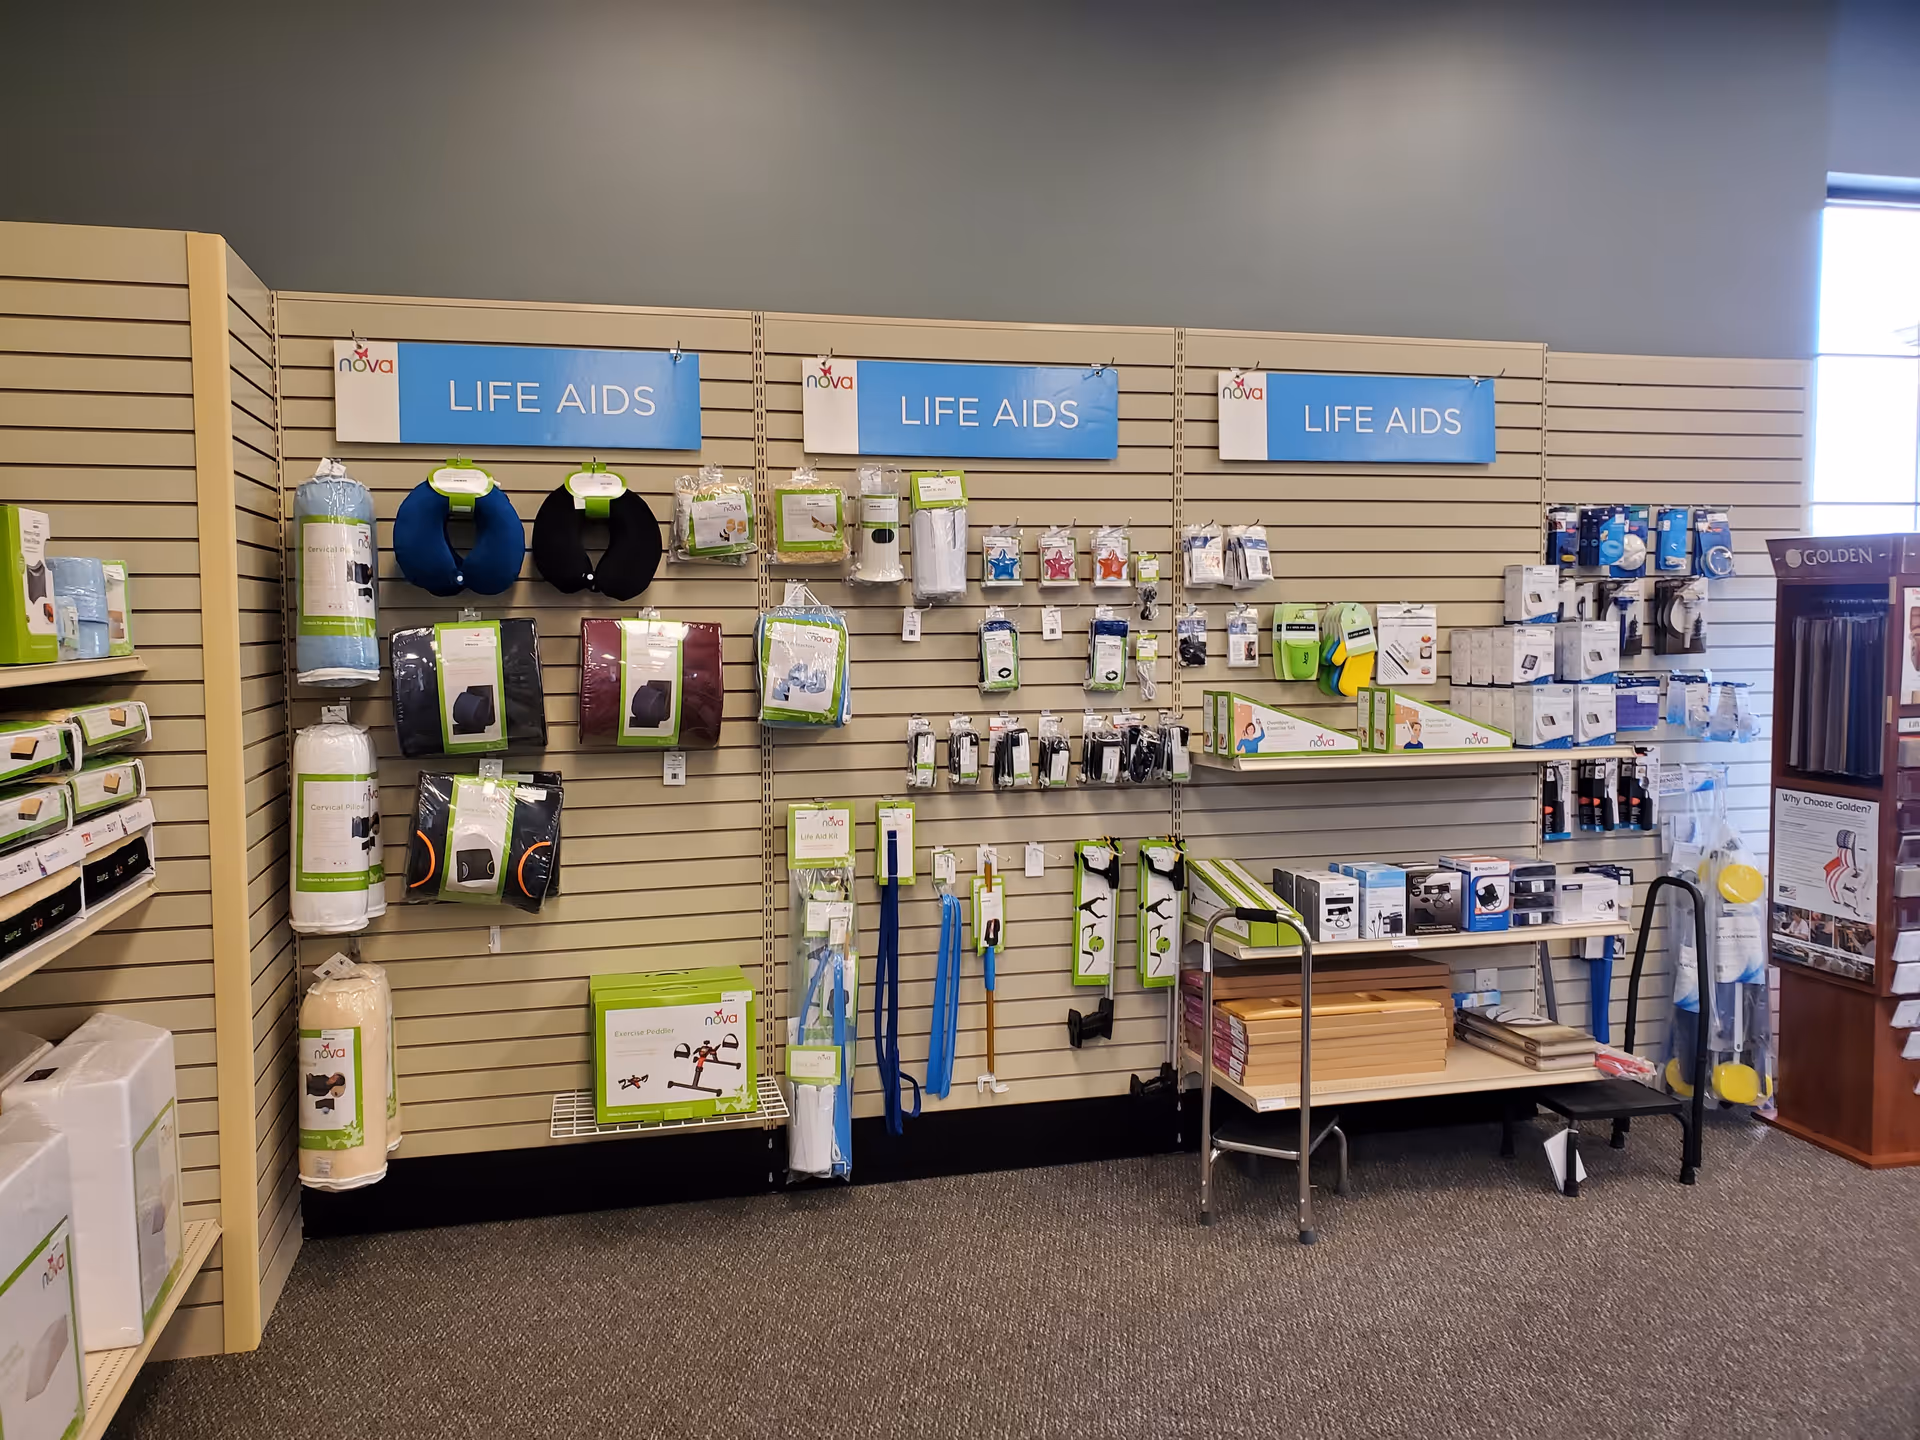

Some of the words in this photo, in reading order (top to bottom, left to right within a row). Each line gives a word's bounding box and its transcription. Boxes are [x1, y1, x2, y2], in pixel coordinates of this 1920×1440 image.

[339, 355, 394, 374] nova
[805, 372, 854, 391] nova
[449, 379, 541, 413] LIFE
[556, 383, 657, 416] AIDS
[1221, 384, 1263, 402] nova
[900, 395, 980, 428] LIFE
[991, 398, 1080, 430] AIDS
[1304, 405, 1373, 433] LIFE
[1385, 407, 1462, 436] AIDS
[307, 545, 338, 554] Cervical
[1803, 546, 1873, 566] GOLDEN
[810, 635, 833, 645] nova
[1309, 738, 1335, 748] nova
[1464, 735, 1489, 745] nova
[310, 803, 344, 812] Cervical
[1782, 793, 1802, 806] Why
[1803, 796, 1834, 810] Choose
[1836, 800, 1872, 815] Golden?
[822, 818, 844, 827] nova
[800, 833, 814, 841] Life
[815, 832, 828, 841] Aid
[828, 832, 839, 840] Kit
[17, 860, 34, 875] BUY!
[704, 1013, 738, 1027] nova
[613, 1028, 645, 1038] Exercise
[646, 1027, 675, 1036] Peddler
[313, 1047, 346, 1060] nova
[41, 1253, 65, 1290] nova
